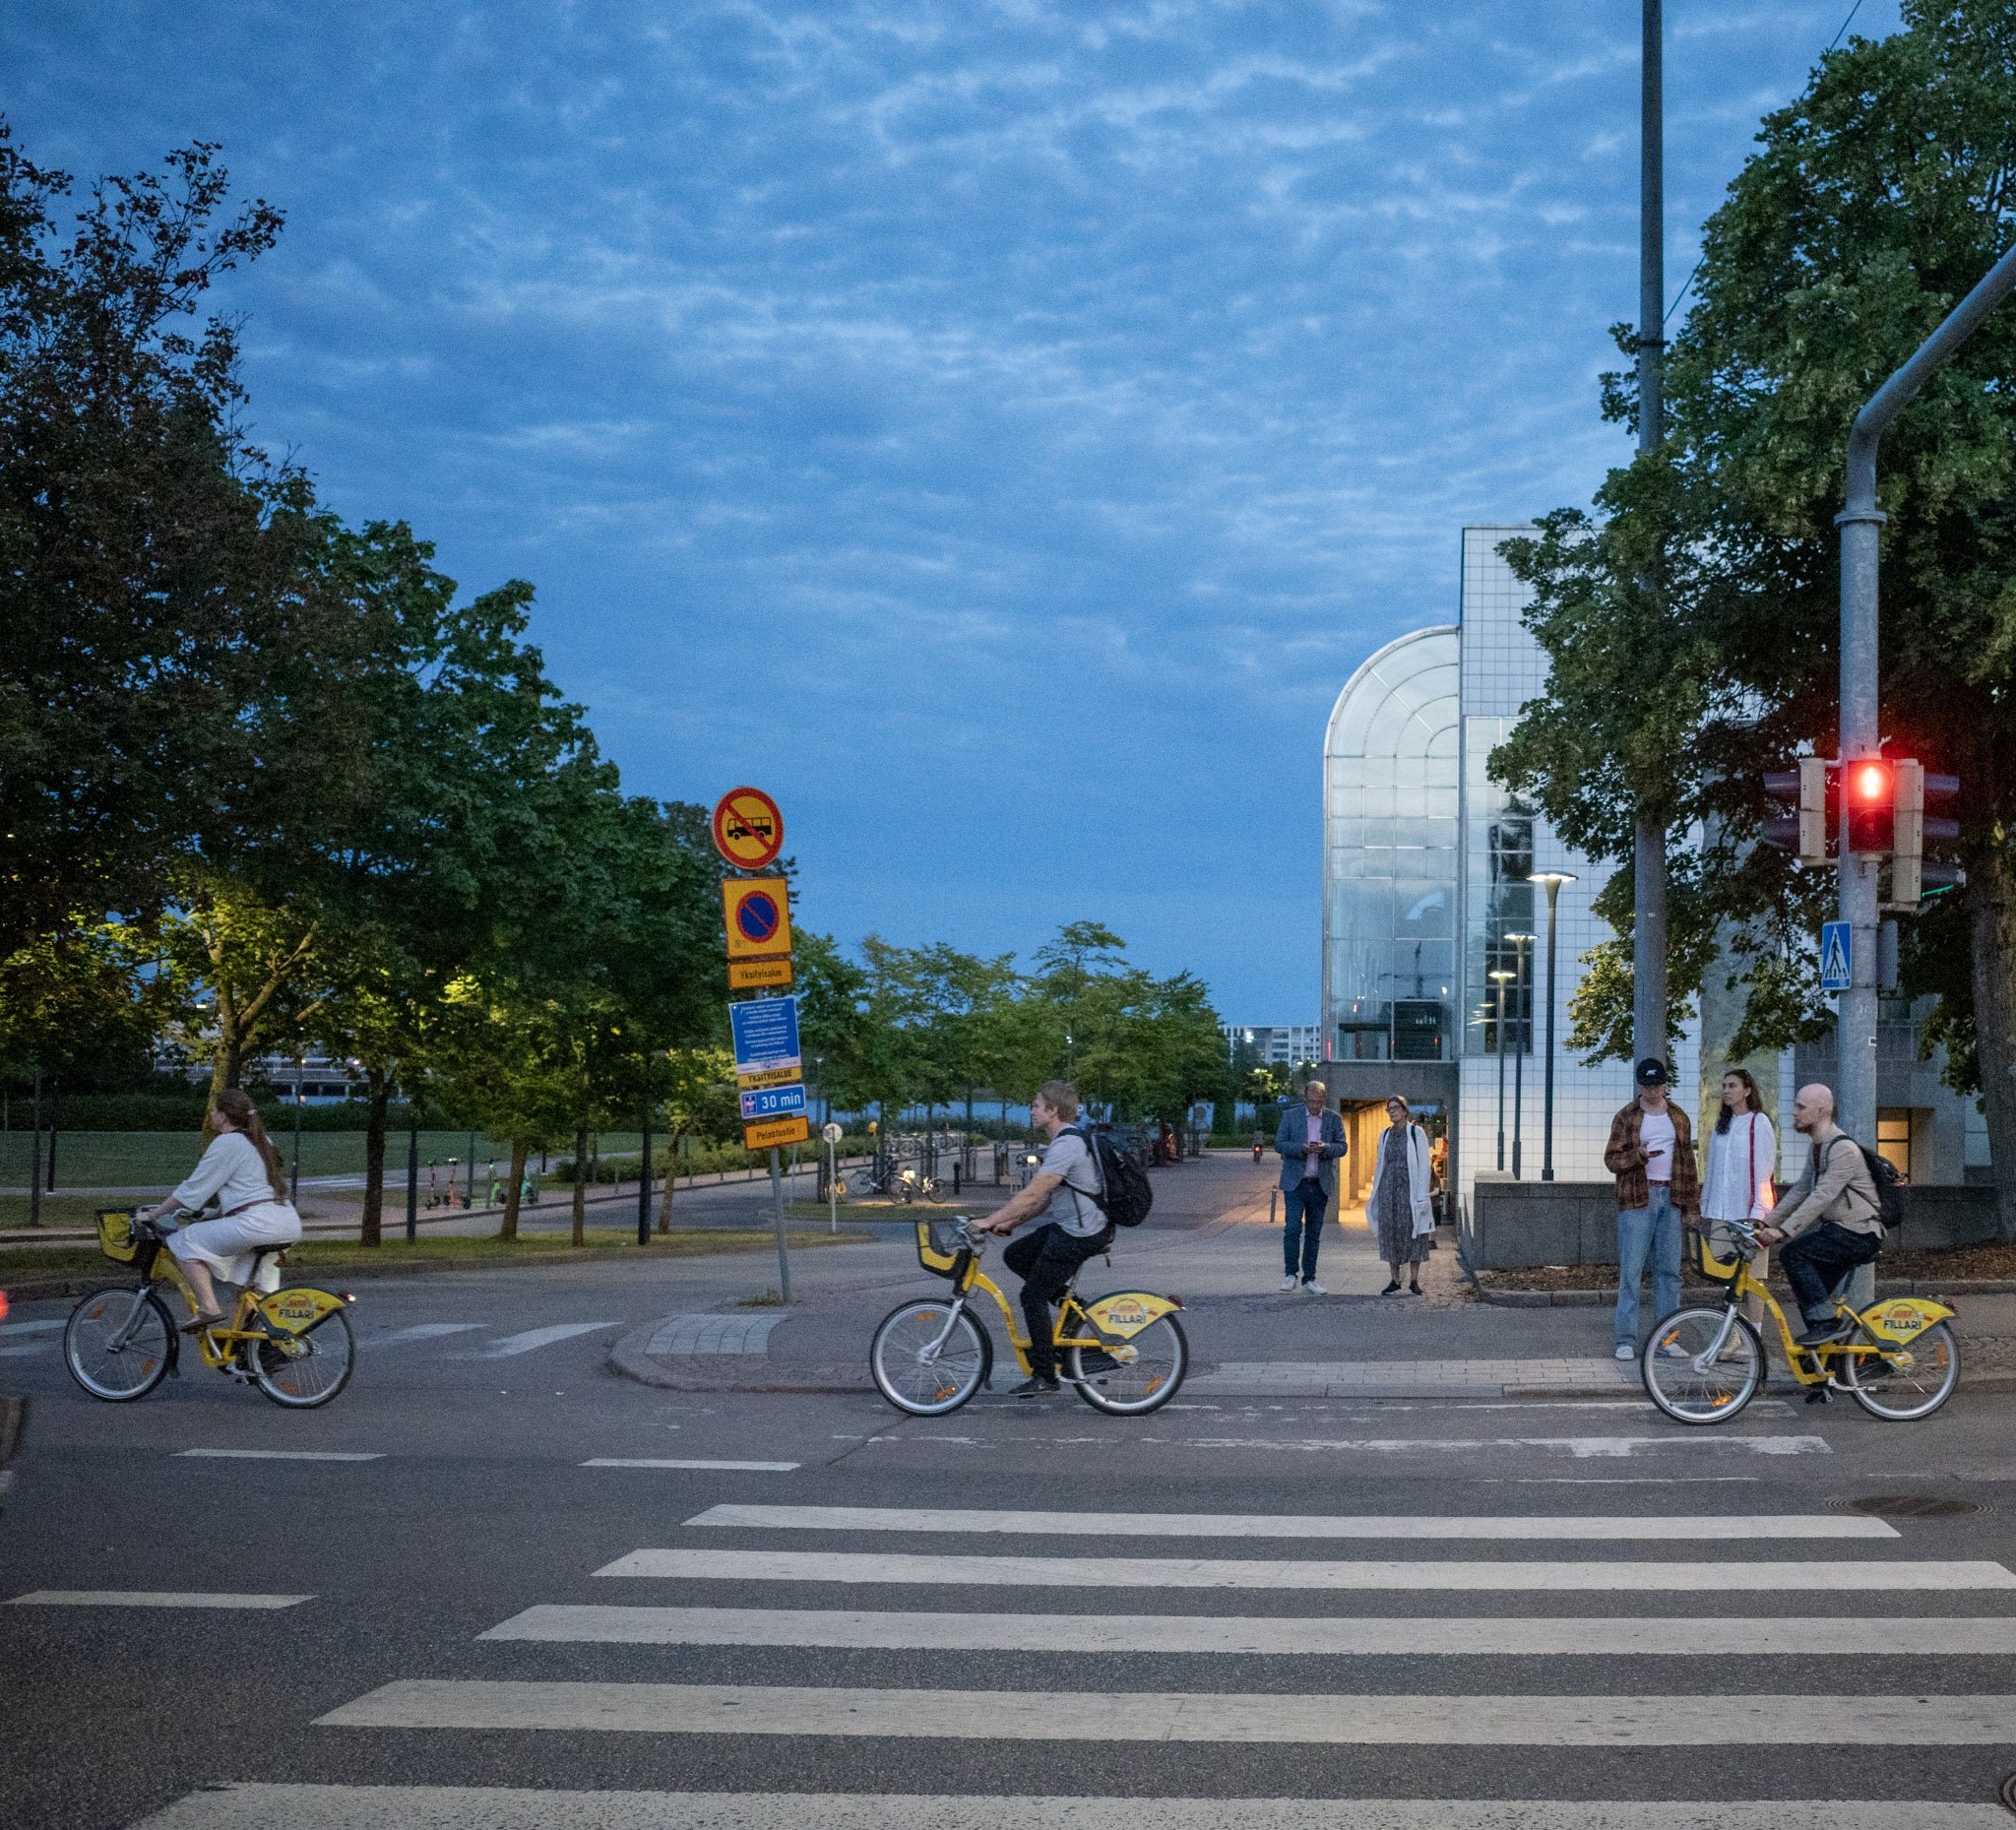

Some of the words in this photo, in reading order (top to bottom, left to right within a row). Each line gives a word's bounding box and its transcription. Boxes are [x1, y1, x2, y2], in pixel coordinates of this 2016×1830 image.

[748, 1069, 792, 1083] YKSITYISALUE
[761, 1095, 777, 1109] 30
[781, 1092, 801, 1107] min
[756, 1127, 795, 1140] Pelastustie
[279, 1308, 314, 1319] FILLARI
[1108, 1314, 1147, 1324] FILLARI
[1883, 1320, 1922, 1330] FILLARI
